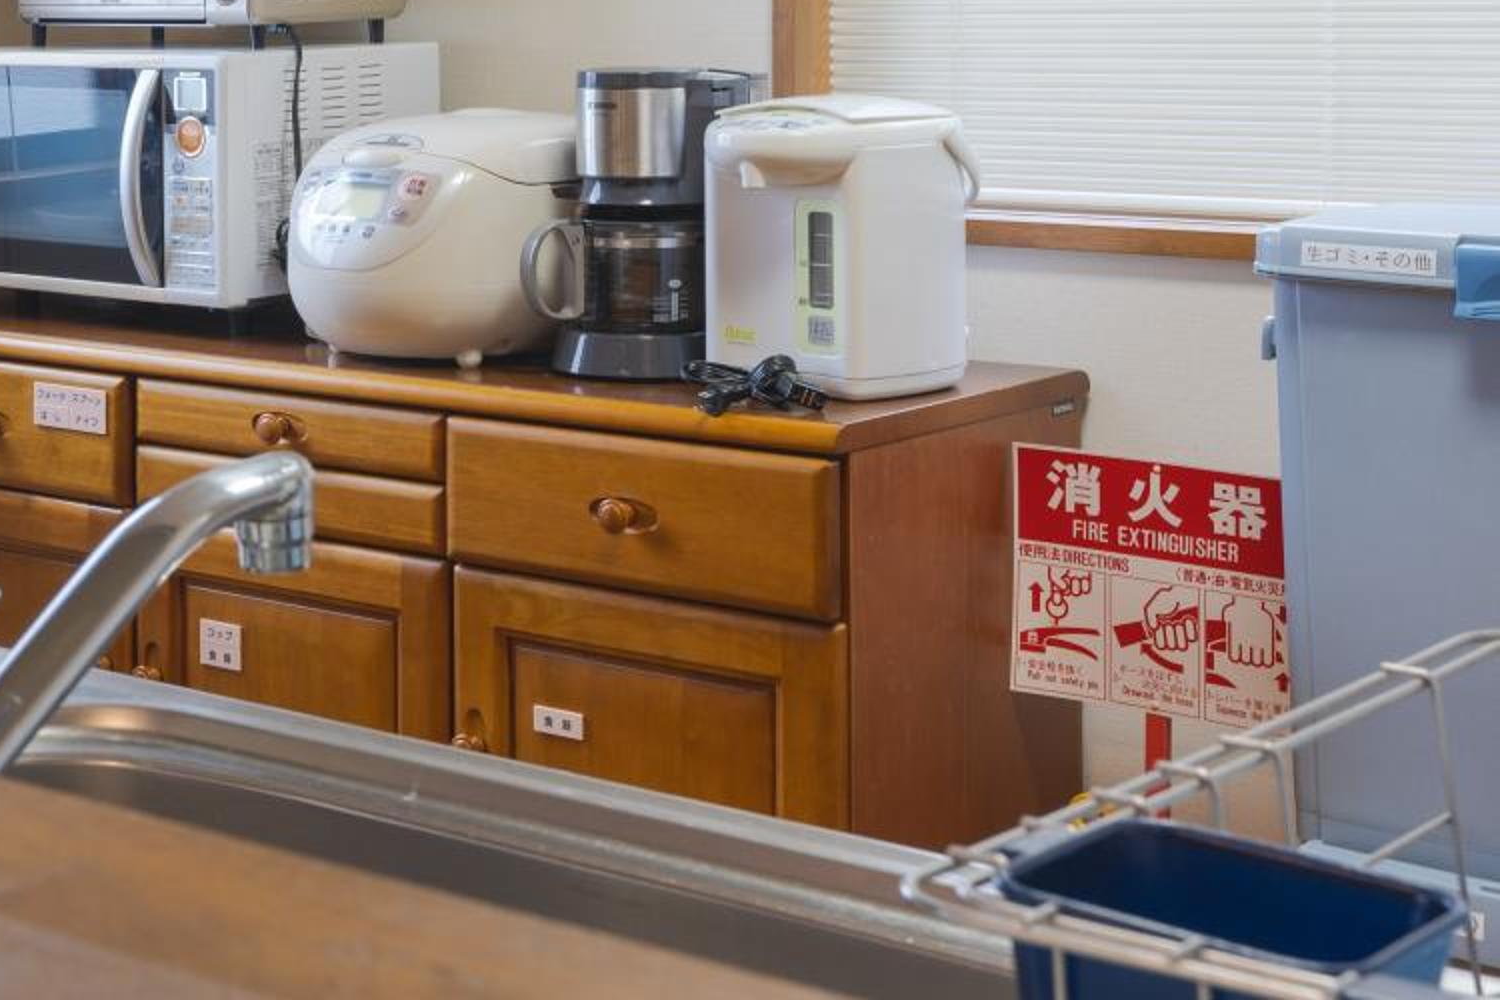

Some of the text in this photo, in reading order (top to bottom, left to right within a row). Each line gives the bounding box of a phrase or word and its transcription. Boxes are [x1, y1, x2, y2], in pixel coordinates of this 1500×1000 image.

[1307, 245, 1432, 272] 生ゴミ・その他
[1045, 458, 1269, 542] 消火器
[1071, 519, 1240, 564] FIRE EXTINGUISHER
